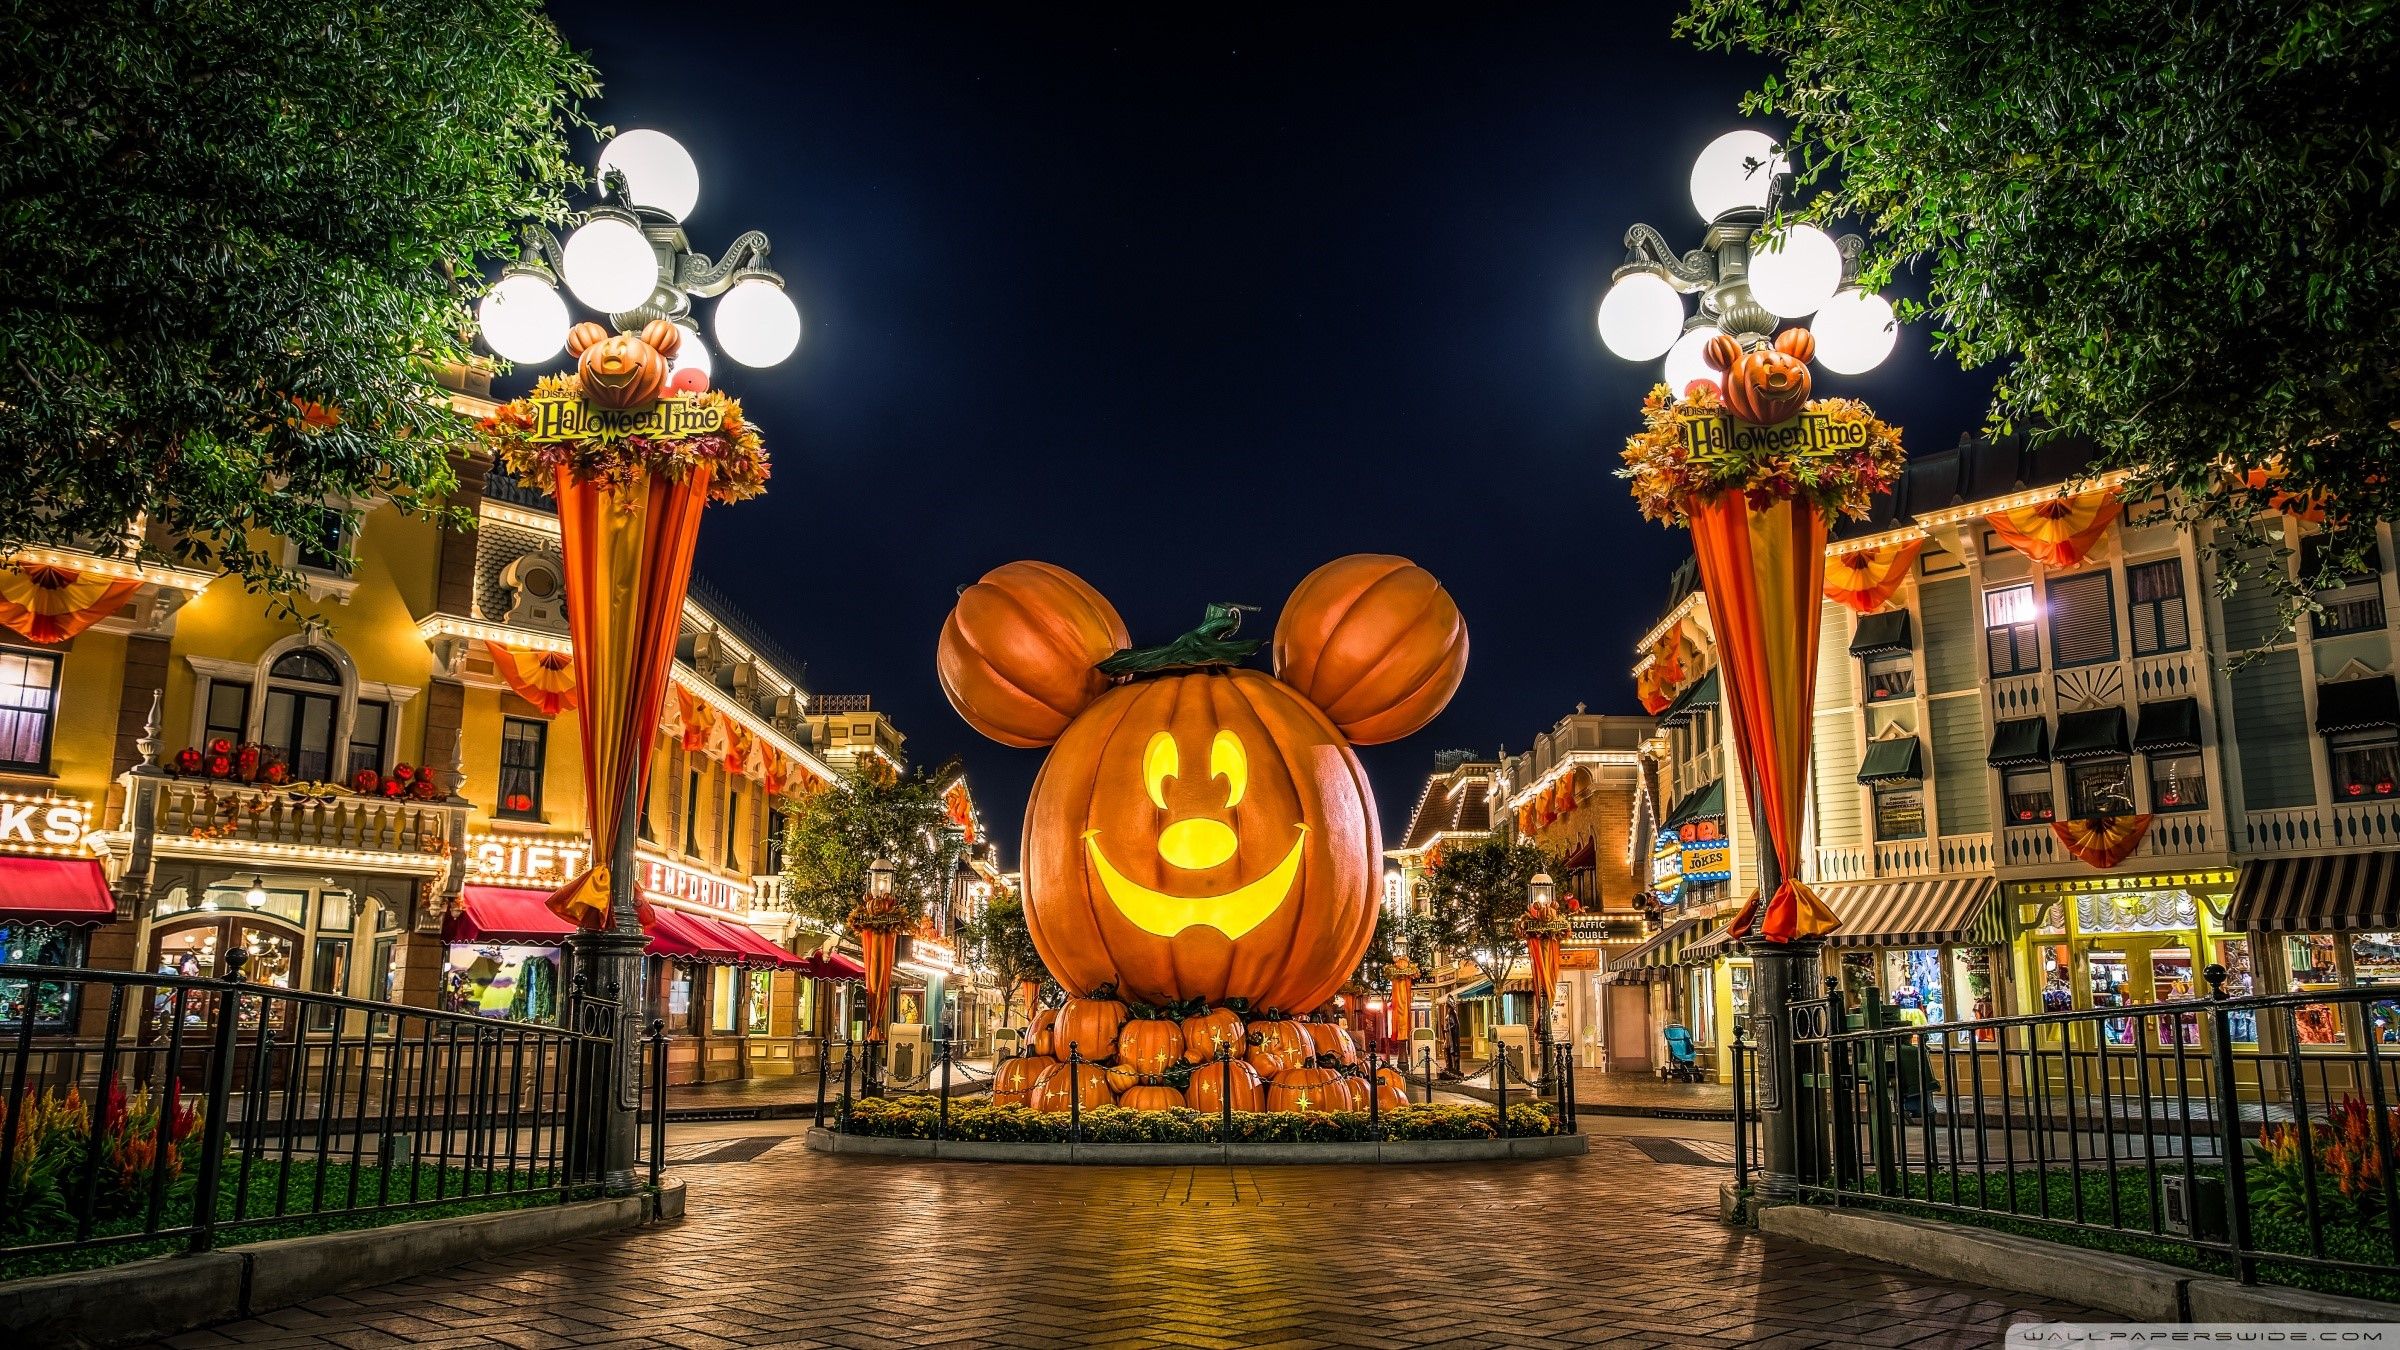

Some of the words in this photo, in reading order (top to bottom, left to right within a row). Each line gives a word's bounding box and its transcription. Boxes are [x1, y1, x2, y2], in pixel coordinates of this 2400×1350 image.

[541, 389, 583, 401] Disney's
[0, 804, 83, 844] KS
[478, 843, 583, 881] GIFT
[1689, 852, 1723, 869] JOKES
[650, 863, 737, 912] EMPORIUM
[1572, 921, 1606, 929] RAFFIC
[1571, 931, 1609, 939] ROUBLE
